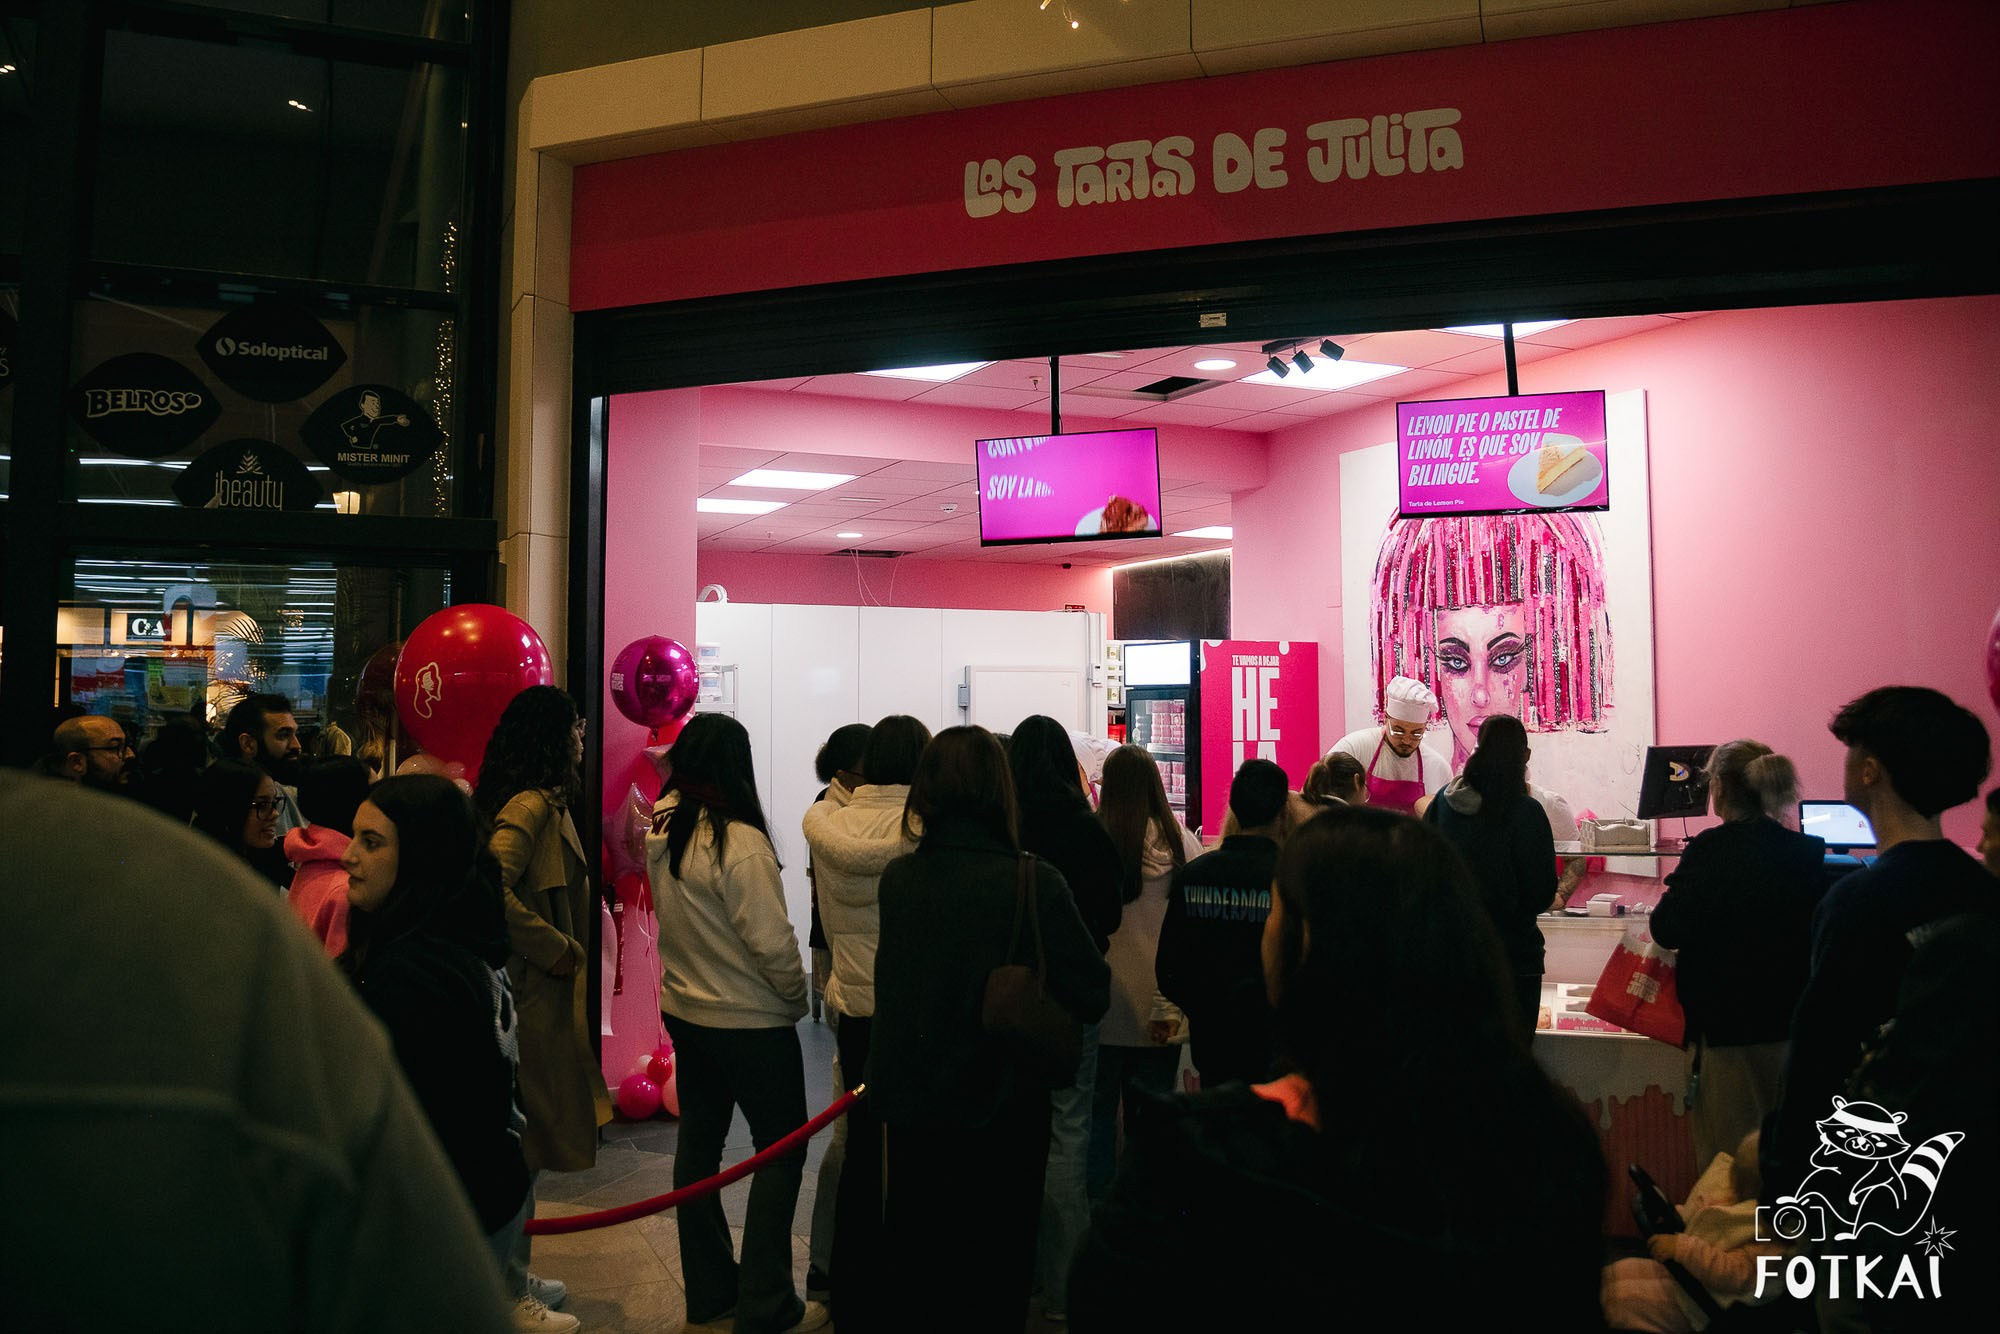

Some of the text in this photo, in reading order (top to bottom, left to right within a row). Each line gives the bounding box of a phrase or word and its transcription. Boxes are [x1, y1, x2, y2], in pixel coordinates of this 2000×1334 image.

[1213, 128, 1289, 193] DE
[238, 341, 329, 361] Soloptical
[1406, 407, 1563, 437] LEMON PIE O PASTEL DE
[337, 452, 411, 464] MISTER MINIT
[1407, 431, 1541, 461] LIMÓN, ES QUE SOY
[1407, 457, 1481, 488] BILINGÜE.
[986, 474, 1018, 501] SOY
[1017, 476, 1034, 499] LA
[131, 618, 167, 636] C&A
[1231, 654, 1240, 666] TE
[1232, 666, 1281, 741] HE
